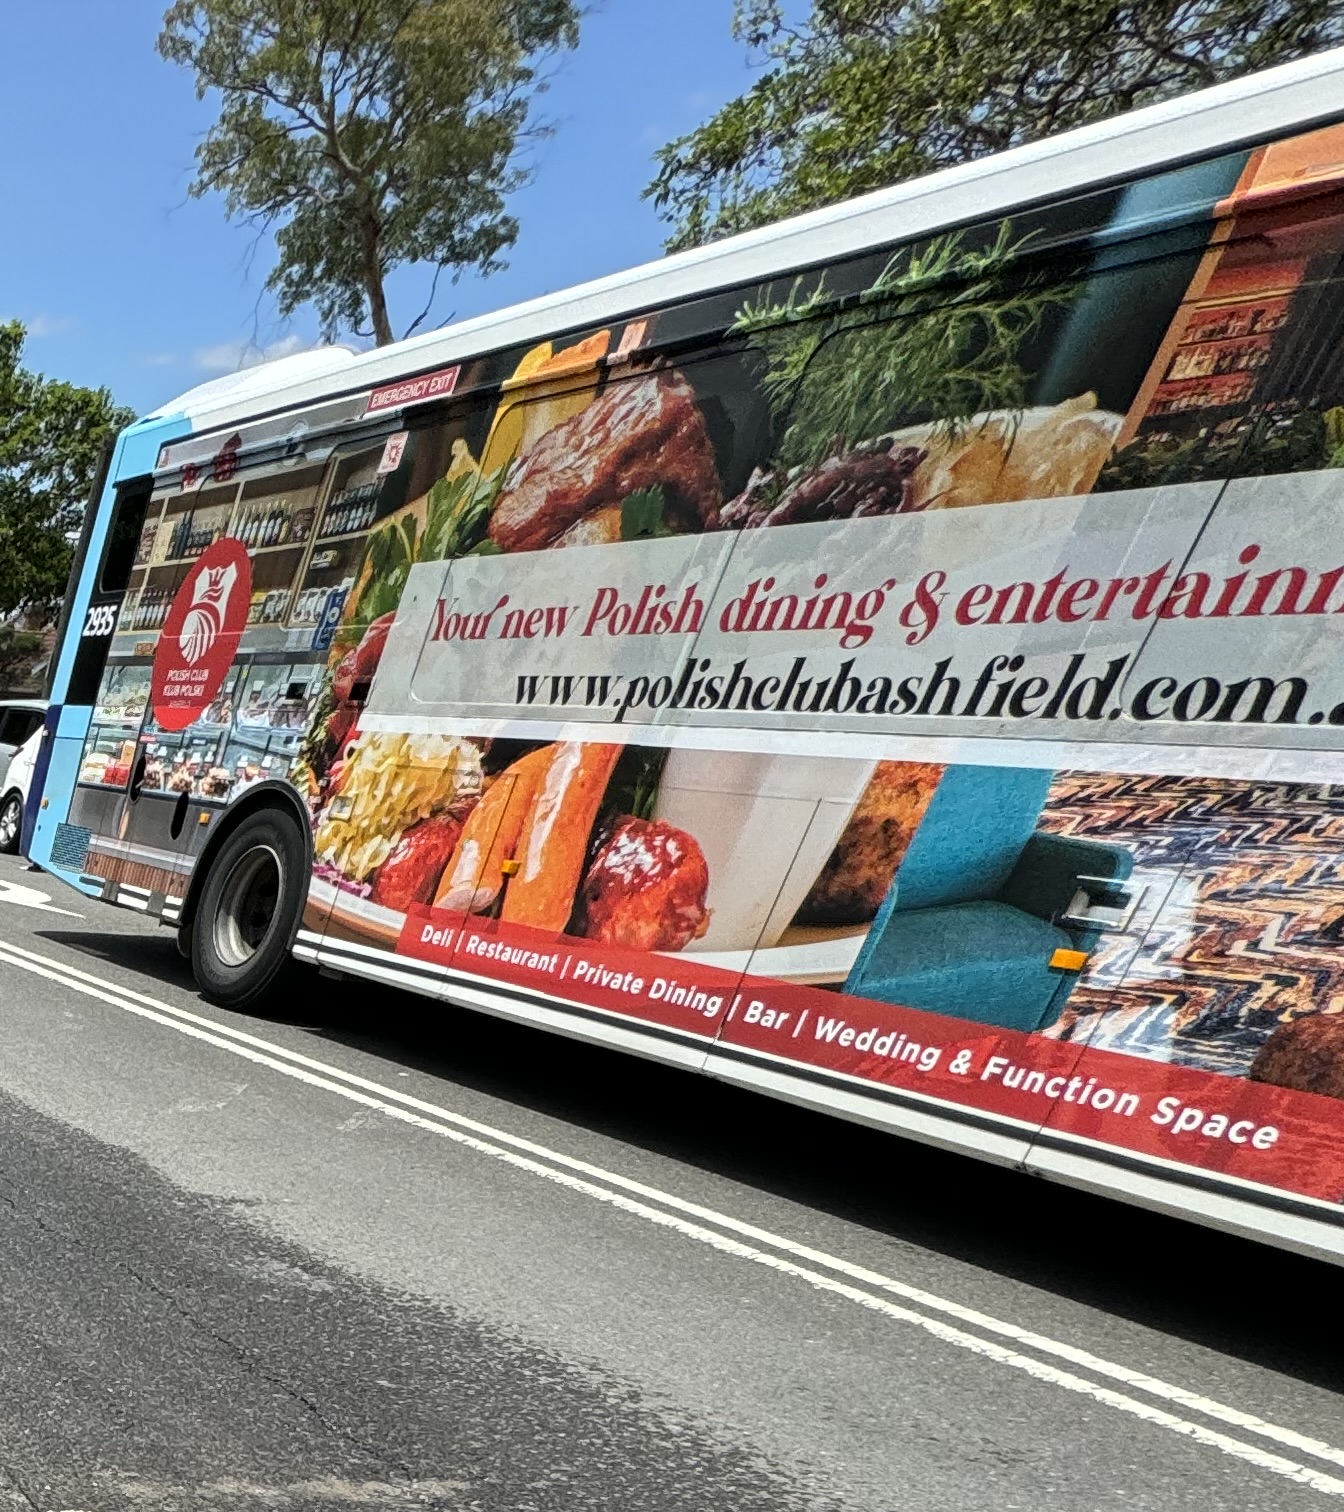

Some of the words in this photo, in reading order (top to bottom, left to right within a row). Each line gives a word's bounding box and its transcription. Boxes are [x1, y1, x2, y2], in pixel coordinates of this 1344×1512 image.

[371, 380, 430, 408] EMERGENCY
[428, 372, 454, 393] EXIT
[82, 604, 118, 637] 2935
[431, 594, 510, 642] Your
[498, 605, 580, 639] new
[581, 581, 705, 637] Polish
[719, 572, 897, 650] dining
[898, 570, 952, 646] &
[420, 924, 454, 948] Deli
[465, 934, 559, 974] Restaurant
[573, 960, 645, 995] Private
[648, 977, 724, 1018] Dining
[743, 1000, 790, 1030] Bar
[814, 1016, 943, 1073] Wedding
[948, 1049, 974, 1076] &
[980, 1055, 1141, 1117] Function
[1150, 1096, 1281, 1150] Space
